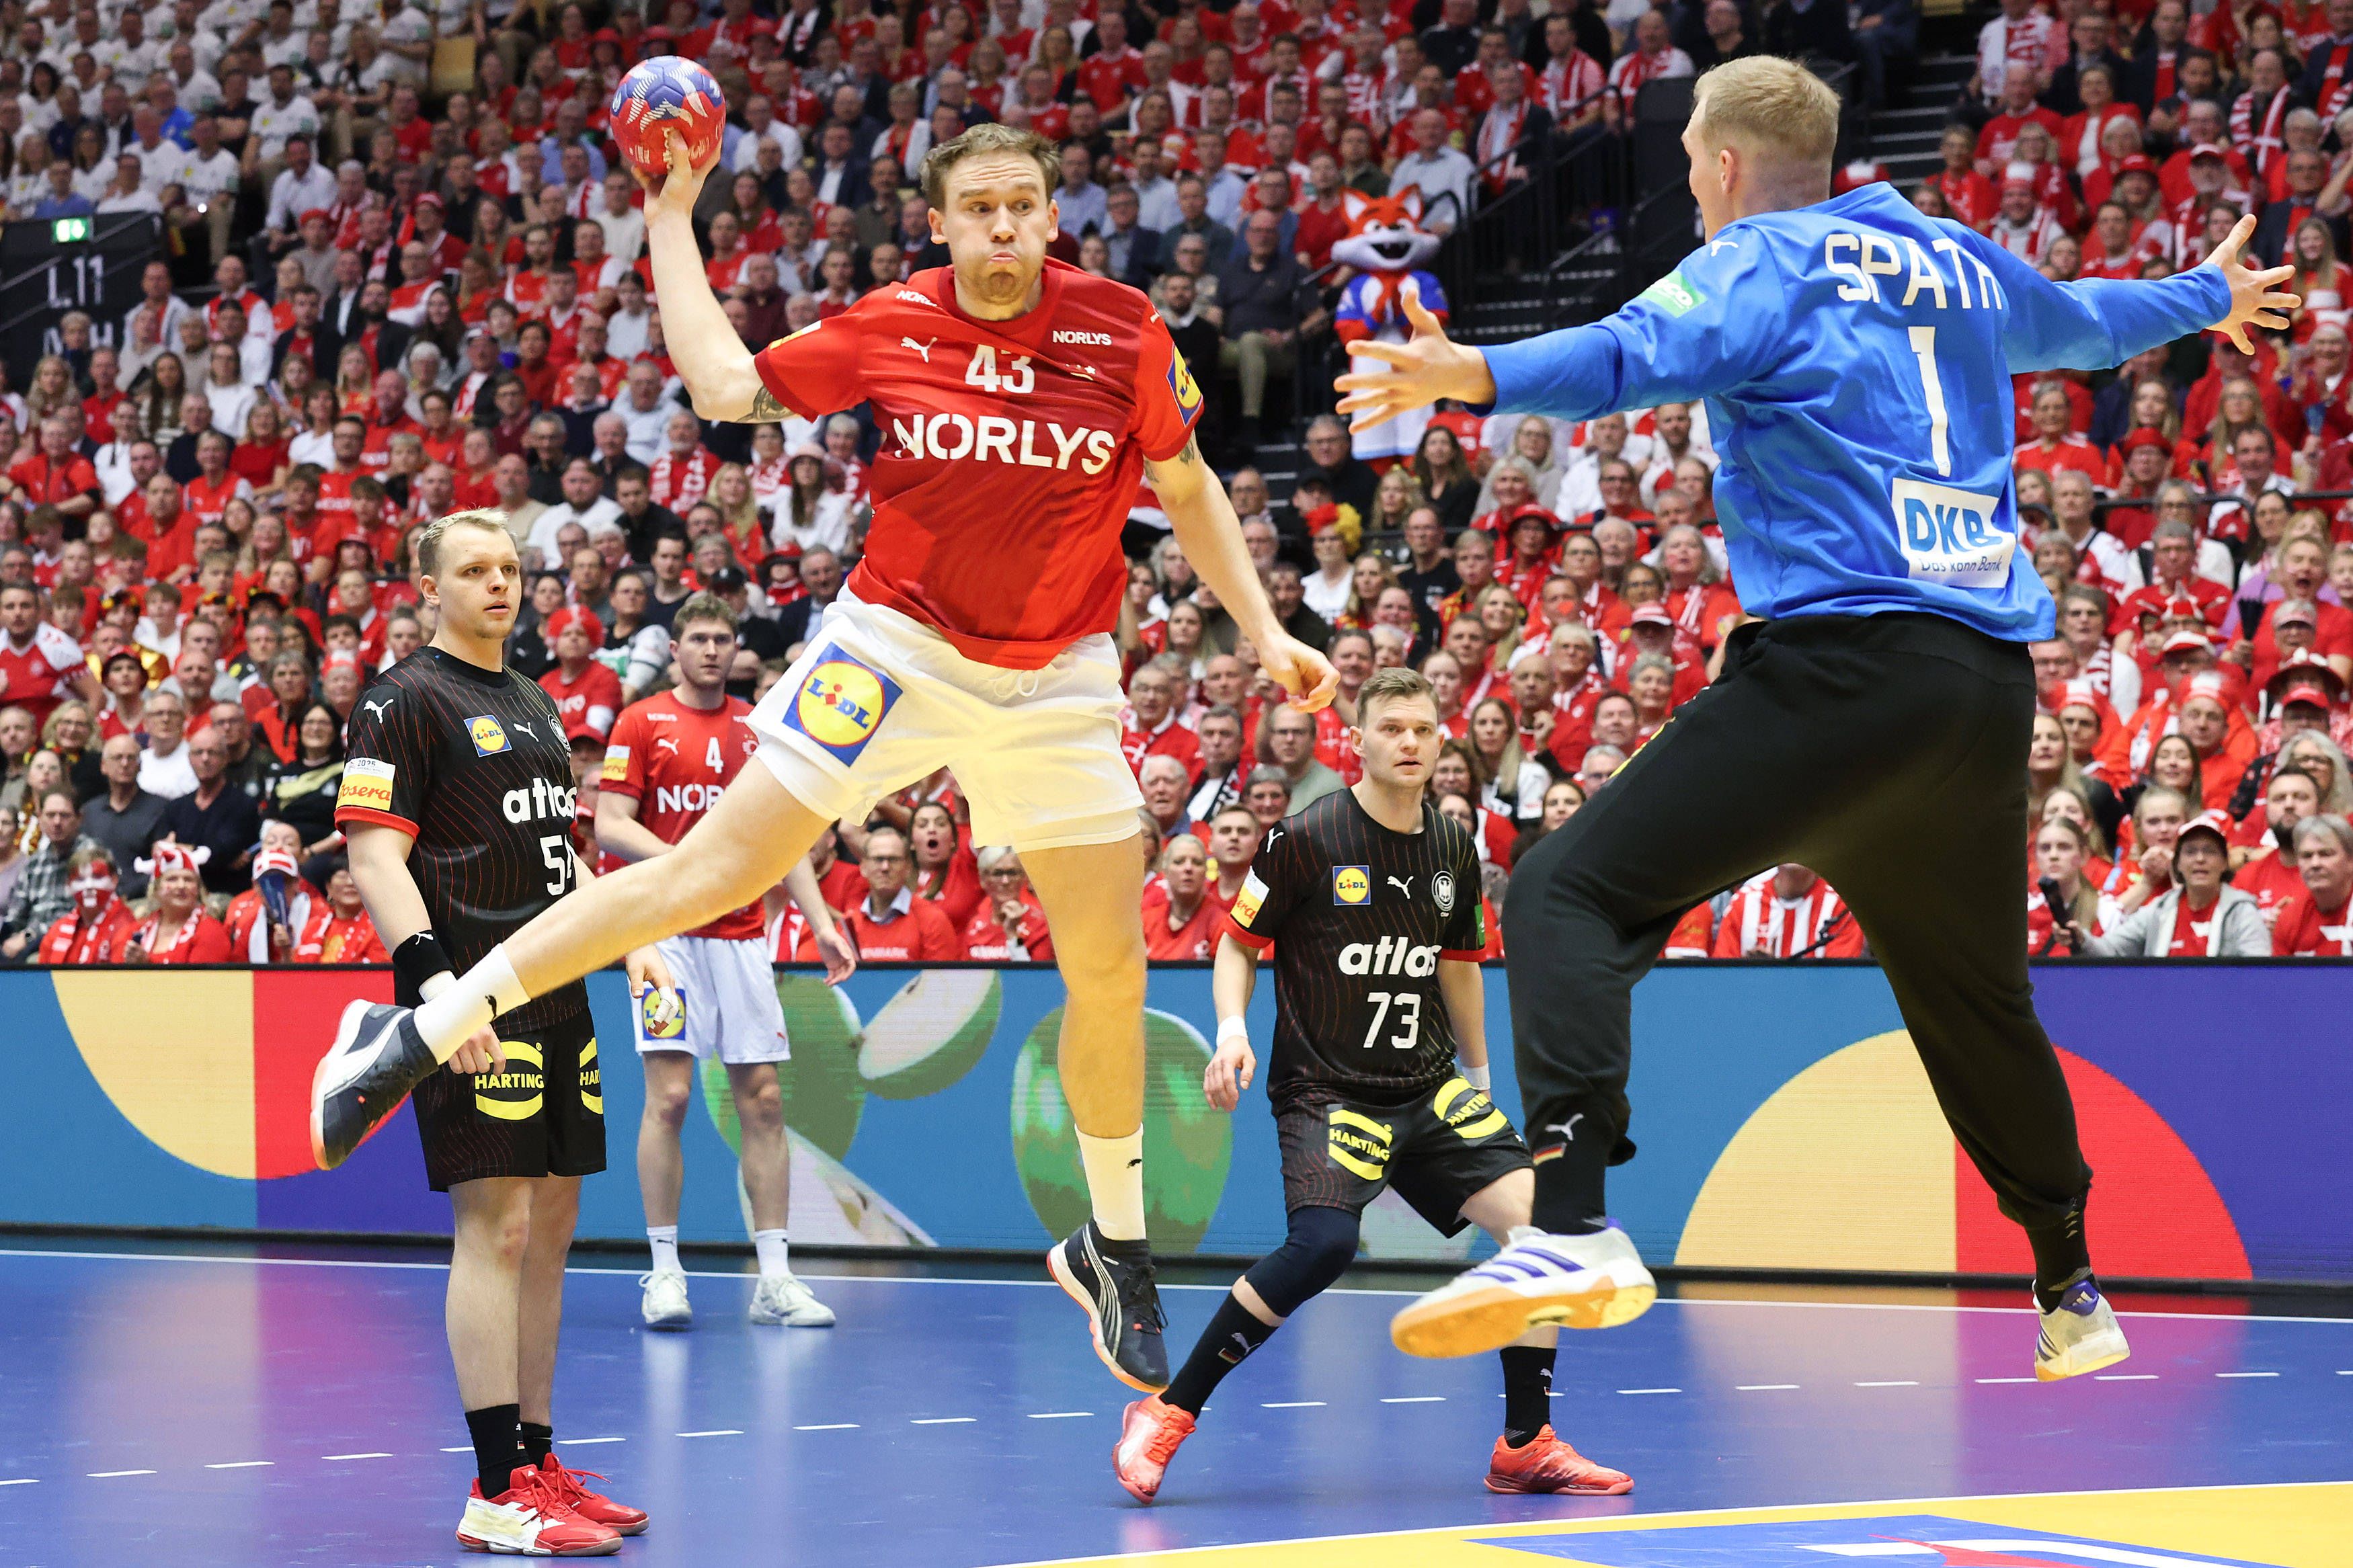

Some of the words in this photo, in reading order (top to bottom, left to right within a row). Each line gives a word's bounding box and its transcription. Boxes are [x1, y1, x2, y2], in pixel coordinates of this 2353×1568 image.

[1052, 330, 1113, 346] NORLYS
[965, 344, 1035, 394] 43
[1908, 325, 1951, 478] 1
[893, 413, 1116, 475] NORLYS
[1904, 498, 2003, 554] DKB
[1978, 555, 2003, 571] Bank
[807, 677, 870, 729] LIDL
[475, 728, 502, 740] LIDL
[705, 737, 724, 774] 4
[502, 777, 578, 824] atlas
[1337, 878, 1366, 890] LIDL
[1338, 936, 1443, 978] atlas
[1363, 991, 1421, 1049] 73
[474, 1073, 545, 1089] HARTING
[1329, 1128, 1390, 1161] HARTING
